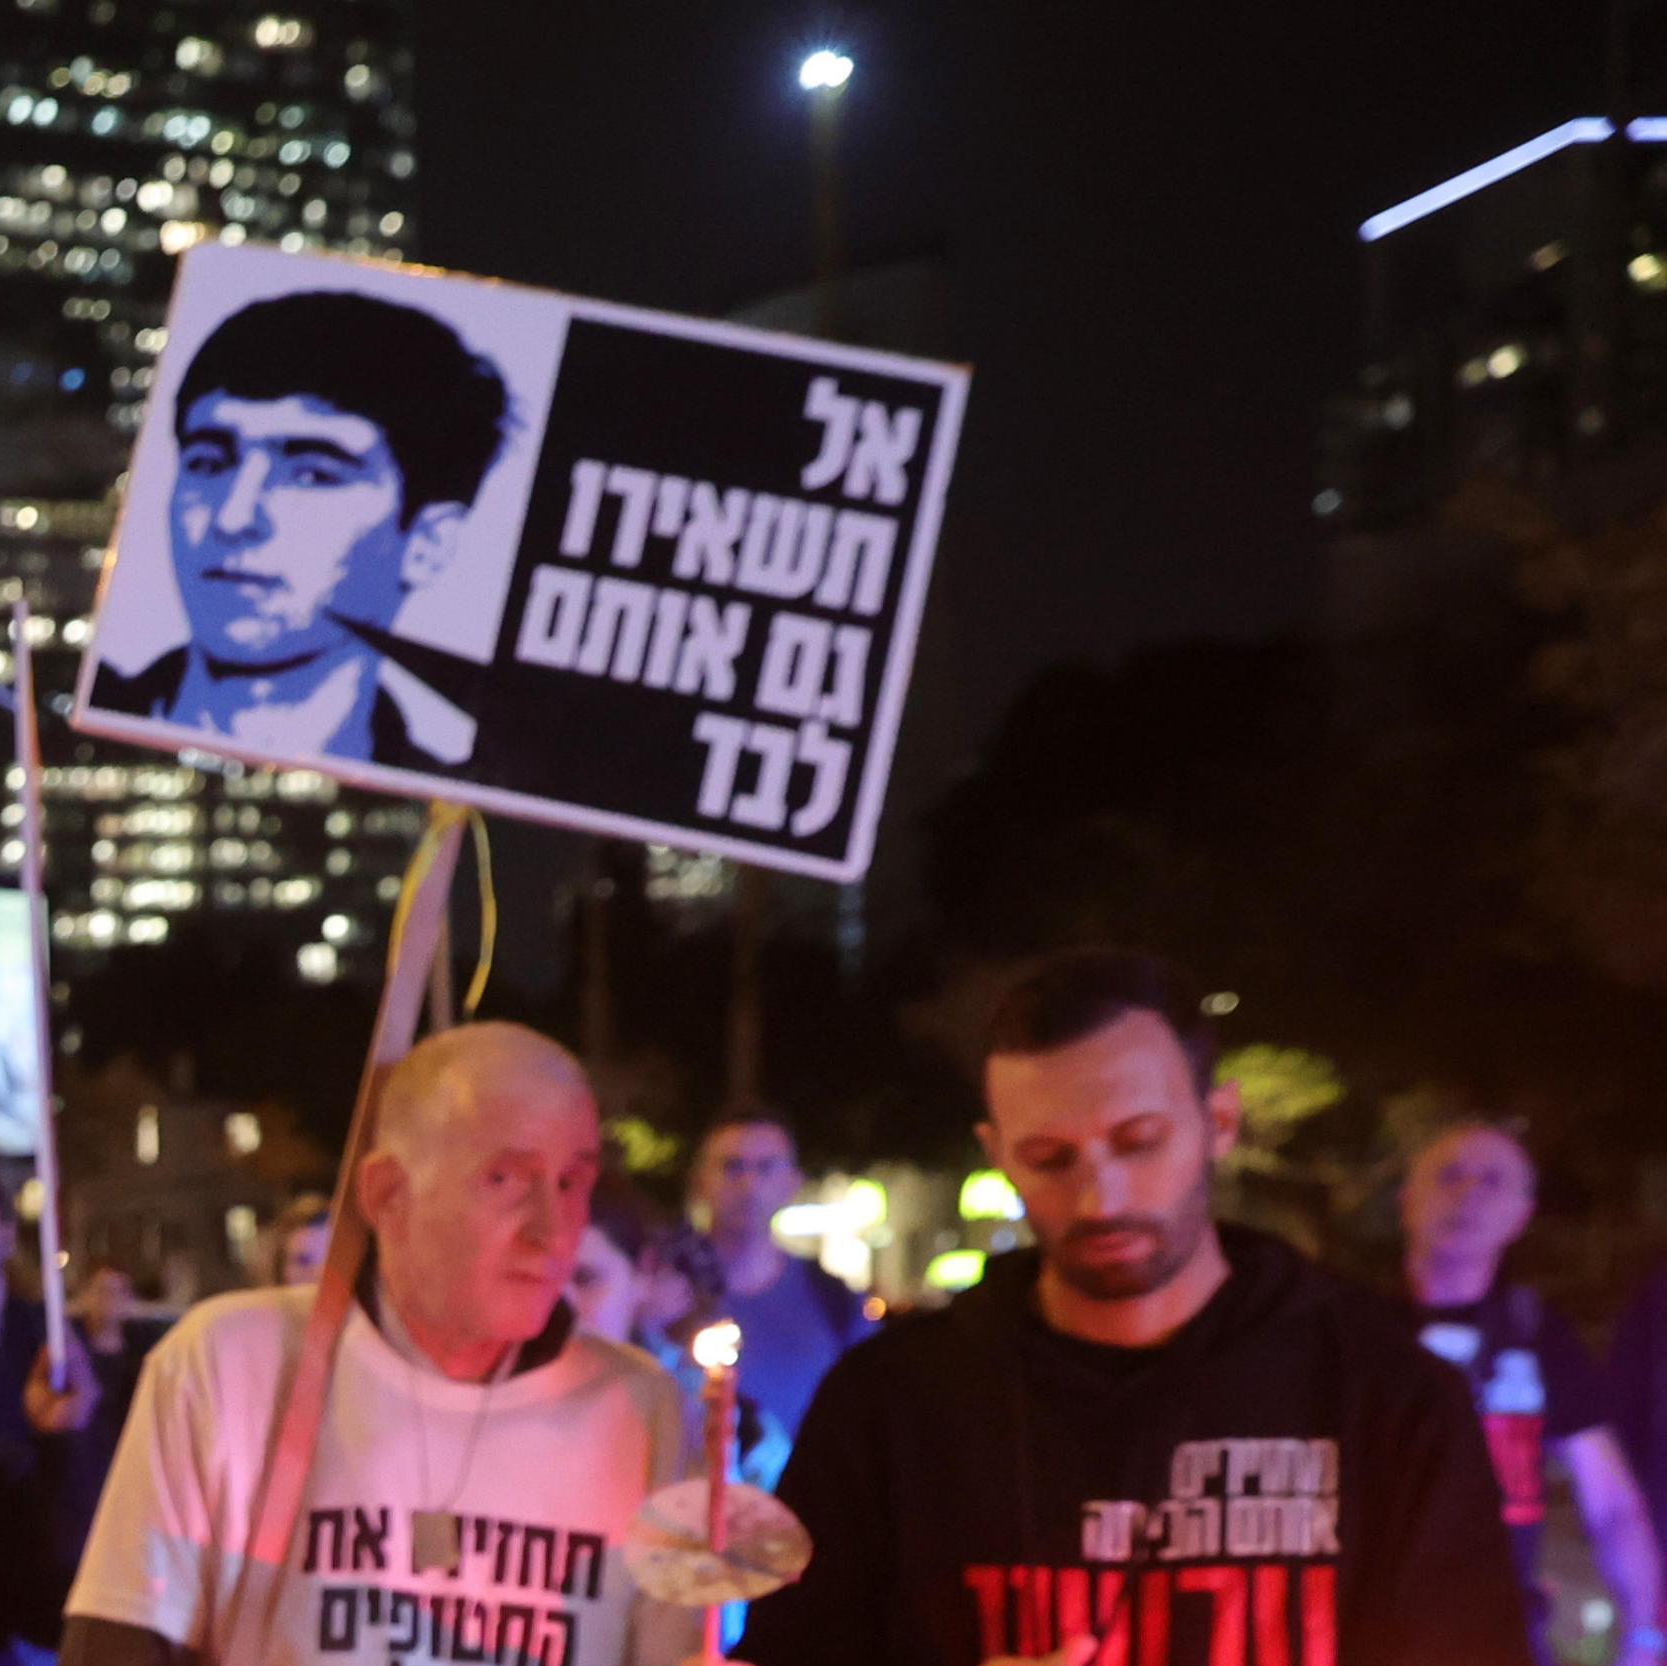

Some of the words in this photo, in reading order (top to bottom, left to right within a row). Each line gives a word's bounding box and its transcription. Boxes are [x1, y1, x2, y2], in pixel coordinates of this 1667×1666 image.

[801, 377, 922, 505] אל
[560, 458, 899, 616] תשאירו
[514, 563, 752, 700] אותם
[754, 612, 872, 729] גם
[693, 711, 852, 838] לבד
[304, 1507, 389, 1574] את
